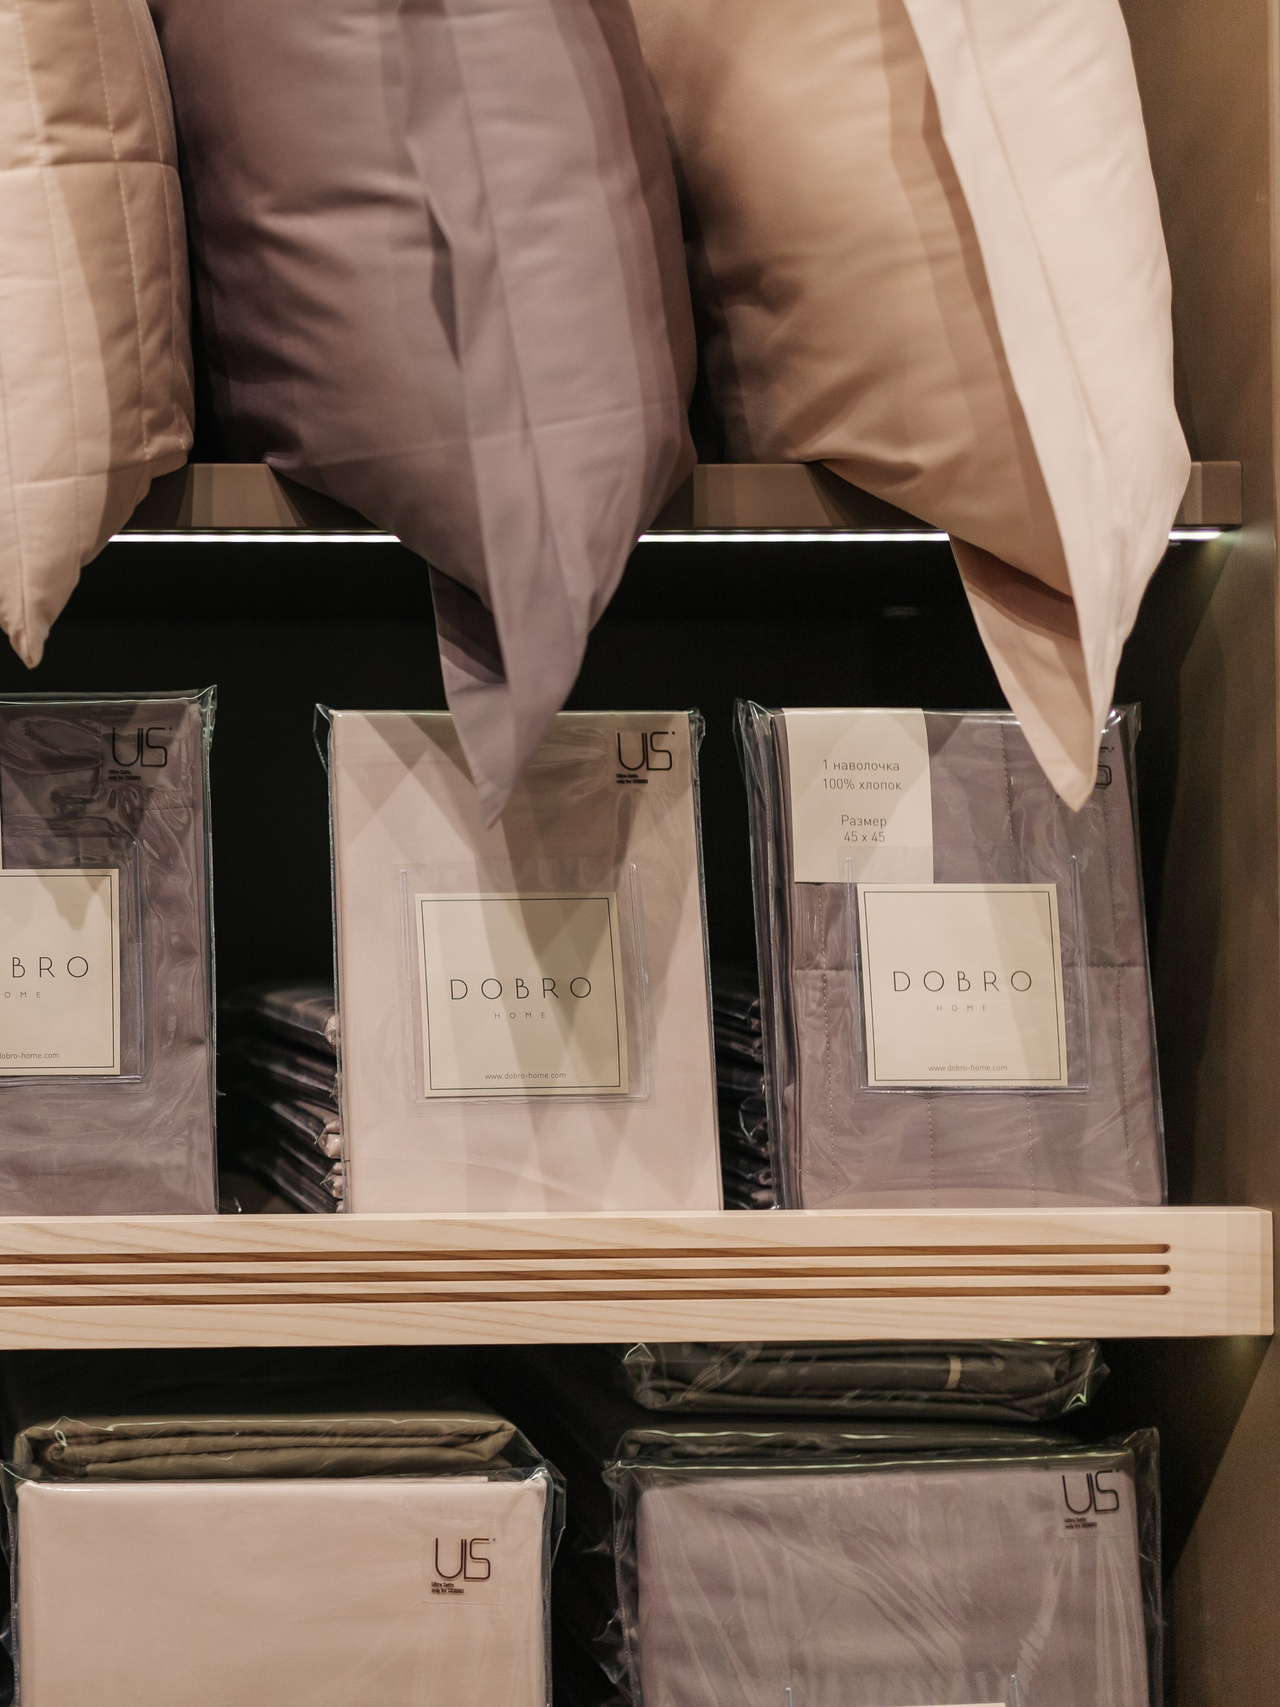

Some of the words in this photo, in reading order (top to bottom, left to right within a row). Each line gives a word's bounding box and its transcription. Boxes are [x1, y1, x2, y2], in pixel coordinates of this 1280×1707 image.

[823, 760, 828, 771] 1
[833, 761, 899, 771] наволочка
[823, 778, 855, 790] 100%
[859, 779, 902, 790] хлопок
[841, 814, 887, 828] Размер
[844, 831, 858, 842] 45
[871, 831, 886, 843] 45
[893, 970, 1032, 992] DOBRO
[450, 977, 591, 1000] DOBRO
[494, 1011, 546, 1019] HOME
[928, 1064, 1008, 1073] www.dobro-home.com
[485, 1071, 567, 1080] www.dobro-home.com
